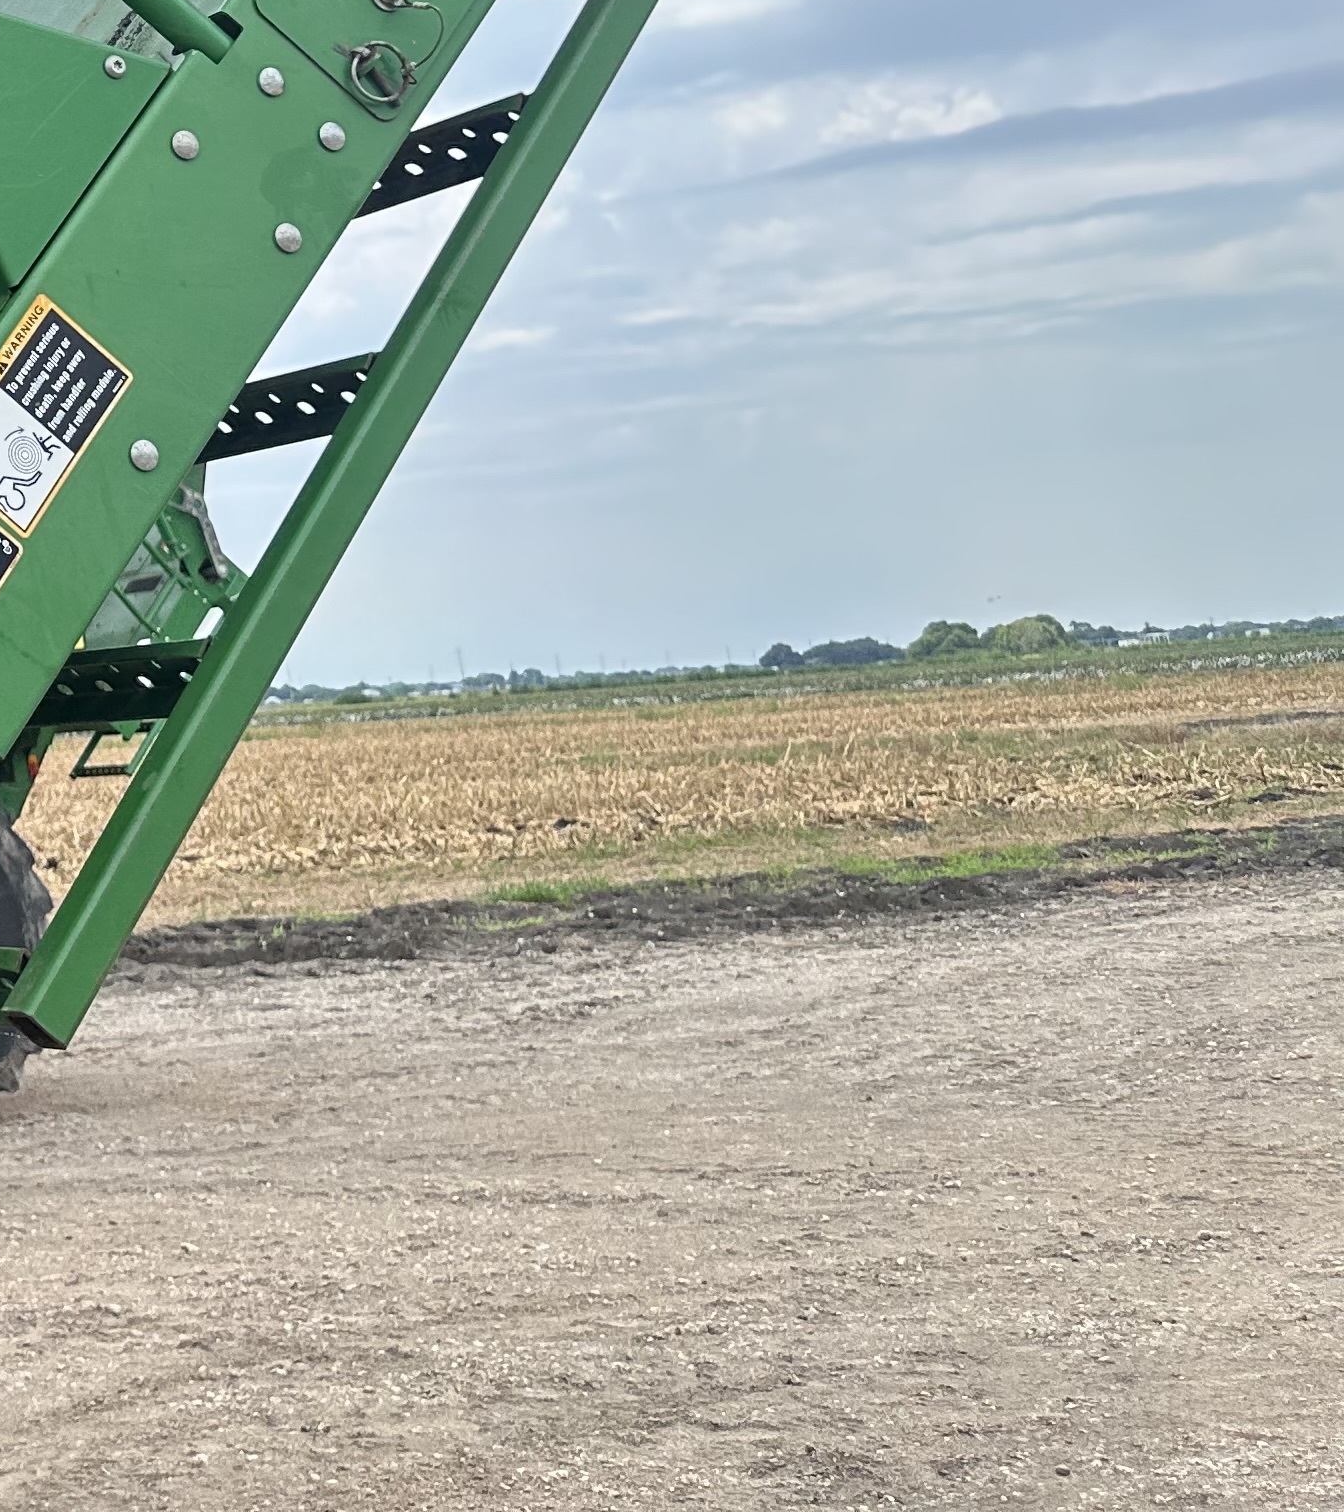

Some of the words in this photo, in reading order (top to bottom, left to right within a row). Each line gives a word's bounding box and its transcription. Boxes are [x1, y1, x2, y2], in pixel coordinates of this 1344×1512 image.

[1, 303, 45, 359] WARNING
[4, 379, 19, 394] To
[13, 349, 40, 385] prevent
[34, 321, 60, 354] serious
[20, 369, 50, 407] crushing
[42, 345, 65, 373] injury
[60, 336, 71, 349] or
[32, 392, 58, 419] death,
[50, 370, 71, 392] keep
[65, 348, 86, 373] away
[46, 408, 66, 430] from
[60, 377, 87, 411] handler
[61, 422, 77, 442] and
[72, 396, 97, 427] rolling
[90, 367, 117, 400] module.
